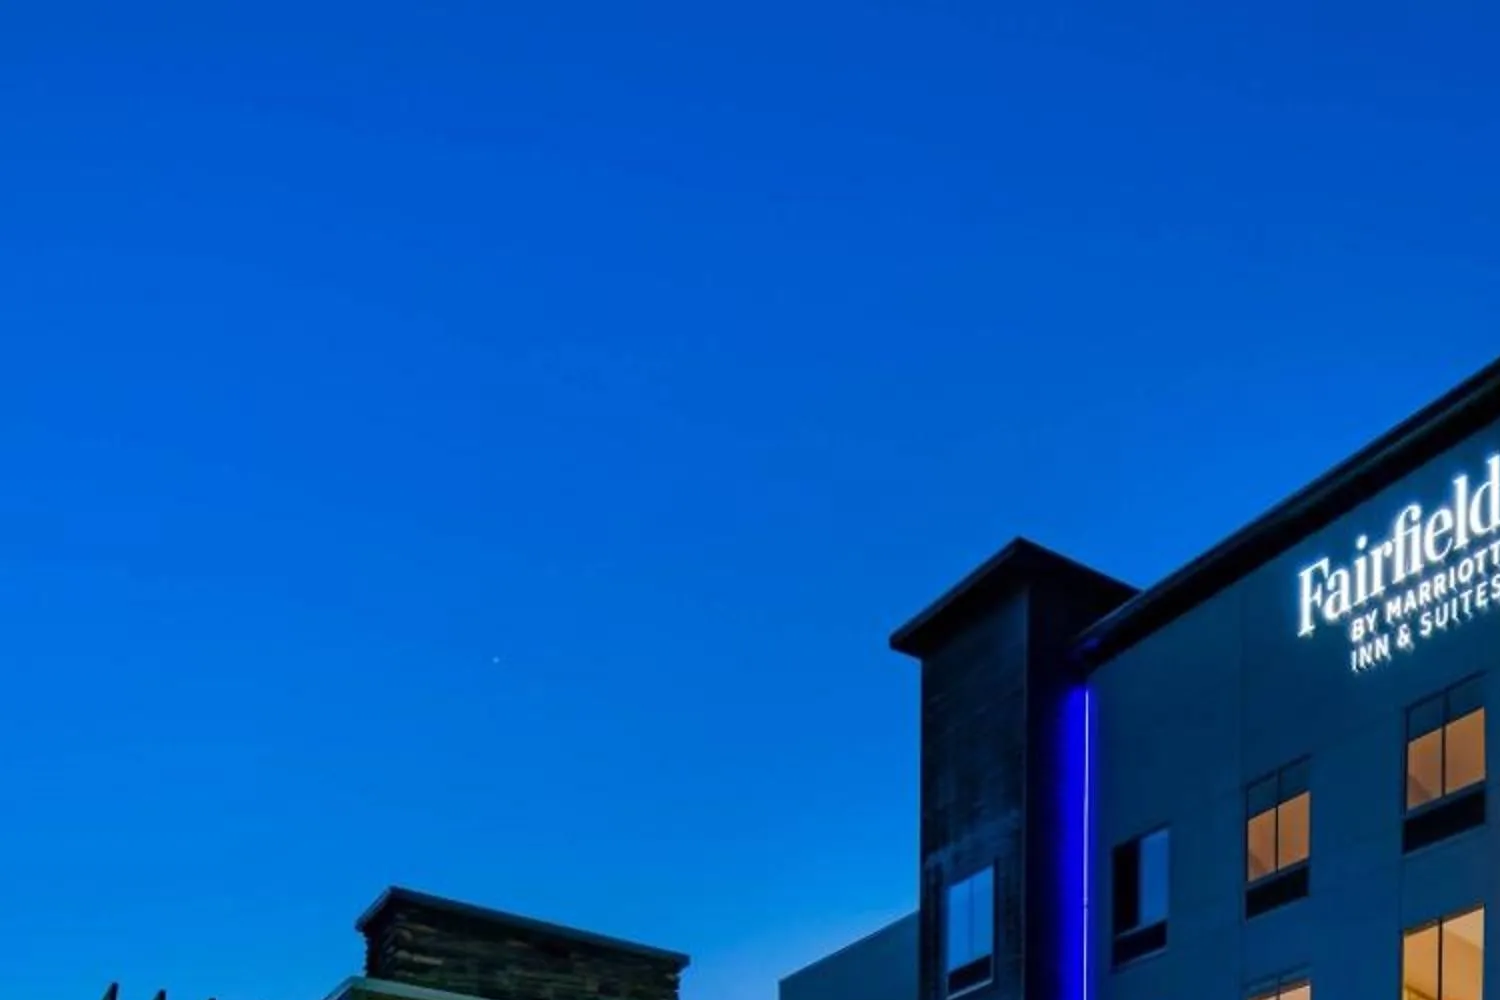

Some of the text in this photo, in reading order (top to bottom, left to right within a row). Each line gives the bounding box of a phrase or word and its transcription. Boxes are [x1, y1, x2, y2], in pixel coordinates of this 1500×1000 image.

[1351, 608, 1378, 643] BY
[1351, 634, 1392, 673] INN
[1396, 623, 1415, 652] &
